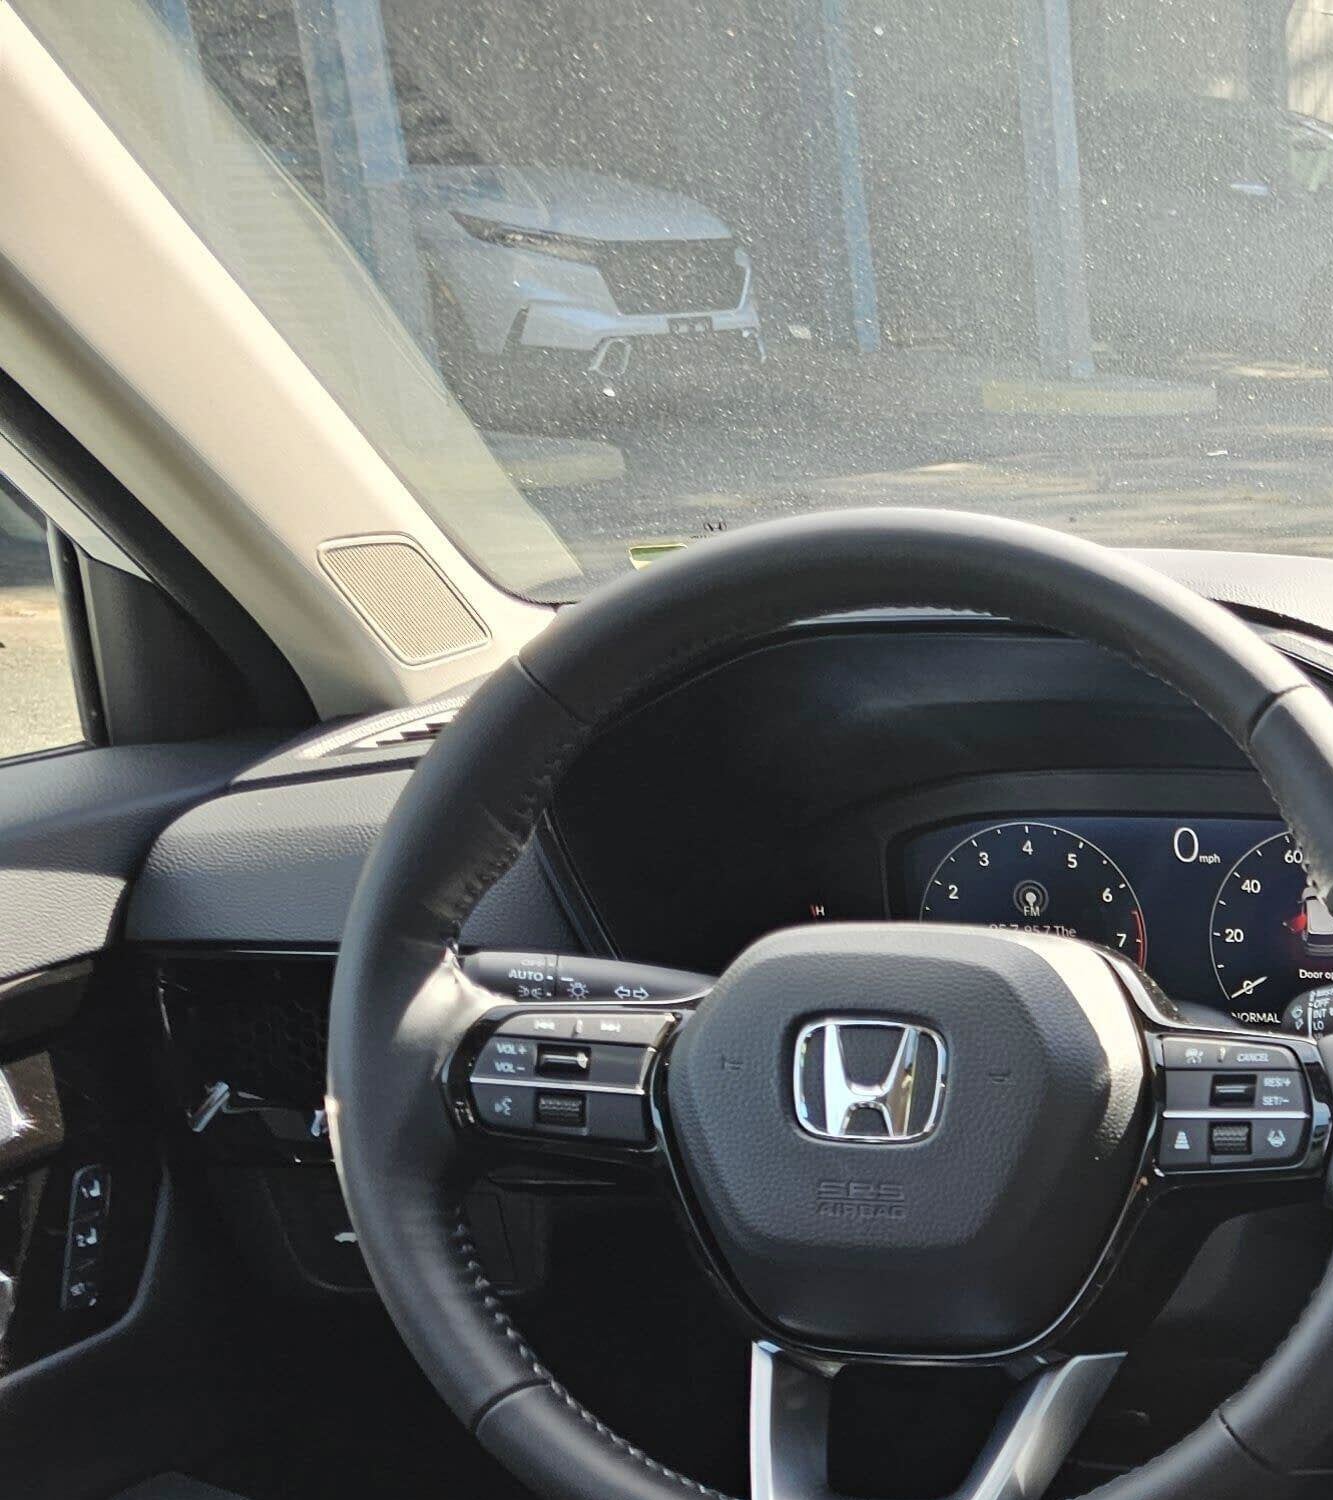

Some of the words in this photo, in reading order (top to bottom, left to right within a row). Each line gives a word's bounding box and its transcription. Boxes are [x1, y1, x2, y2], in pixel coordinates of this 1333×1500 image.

[1022, 840, 1034, 856] 4
[1173, 826, 1199, 863] 0
[1200, 853, 1221, 865] mph
[978, 851, 990, 867] 3
[1067, 853, 1078, 869] 5
[1284, 850, 1303, 864] 60
[948, 884, 960, 900] 2
[1240, 879, 1261, 894] 40
[1102, 887, 1113, 903] 6
[1023, 905, 1041, 917] FM
[1054, 925, 1077, 937] The
[1224, 928, 1245, 943] 20
[1116, 933, 1127, 948] 7
[508, 967, 544, 982] AUTO
[1299, 969, 1323, 979] Door
[496, 1042, 518, 1055] VOL
[1236, 1053, 1270, 1063] CANCEL
[494, 1061, 516, 1073] VOL
